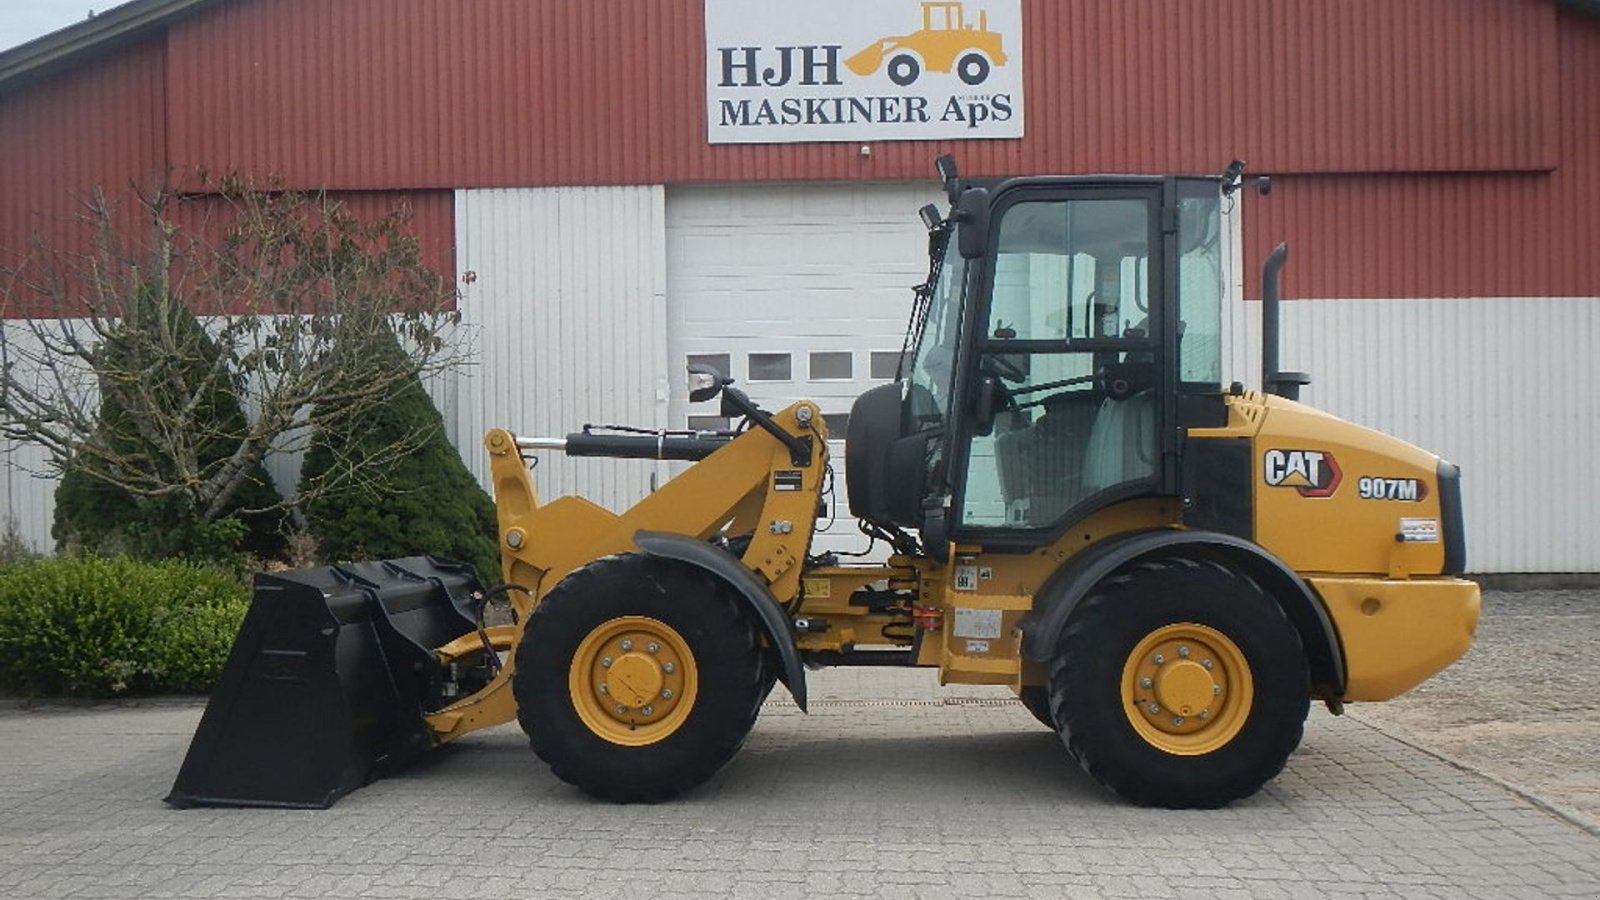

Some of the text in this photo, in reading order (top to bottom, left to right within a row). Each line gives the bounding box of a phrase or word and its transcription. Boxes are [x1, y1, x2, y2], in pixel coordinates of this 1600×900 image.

[717, 45, 843, 87] HJH
[719, 93, 1012, 128] MASKINER ApS
[1265, 449, 1323, 487] CAT
[1359, 477, 1418, 499] 907M
